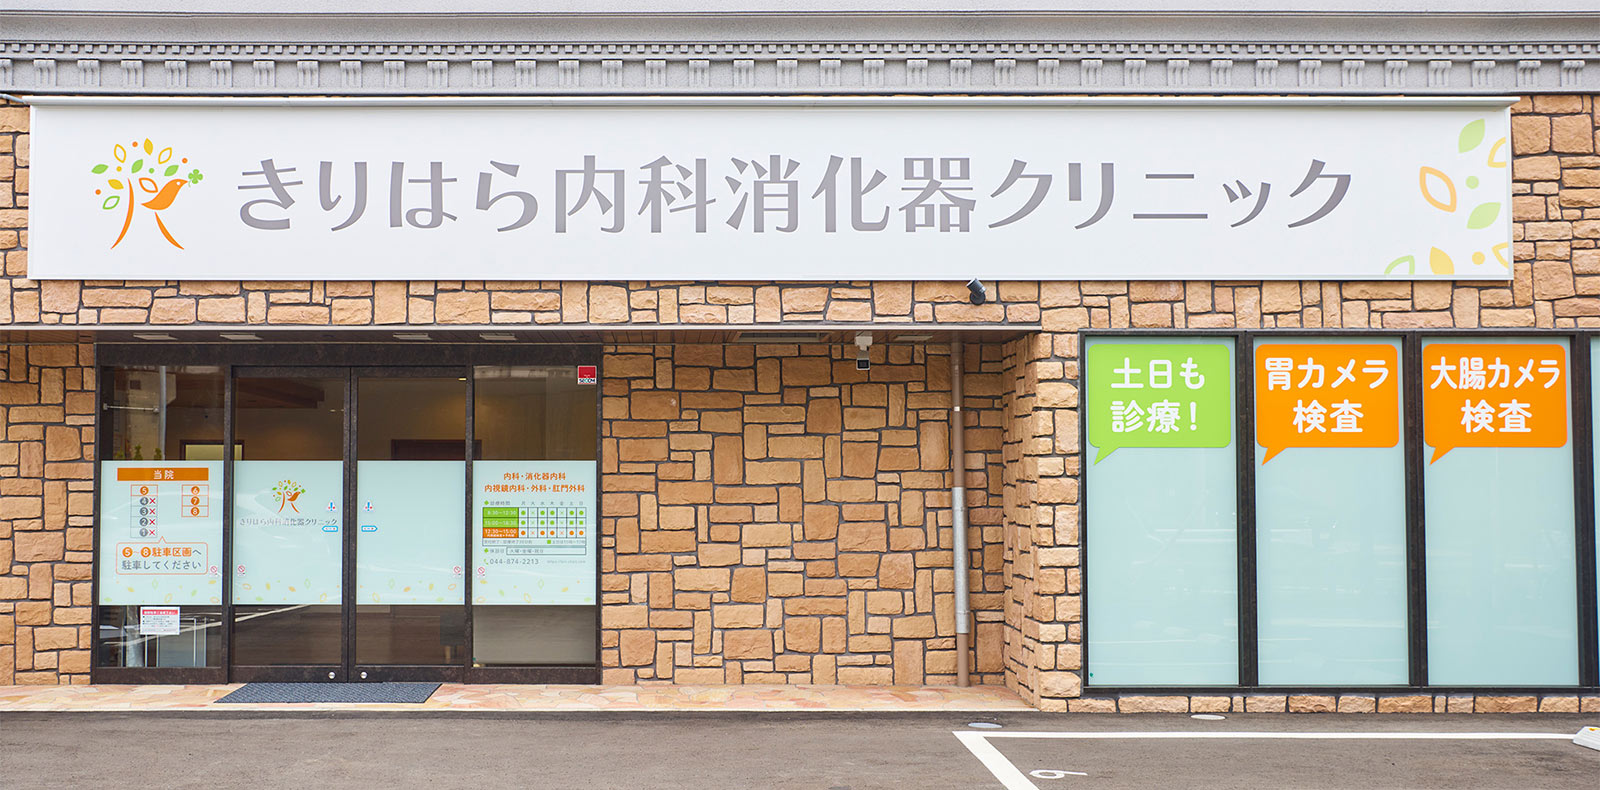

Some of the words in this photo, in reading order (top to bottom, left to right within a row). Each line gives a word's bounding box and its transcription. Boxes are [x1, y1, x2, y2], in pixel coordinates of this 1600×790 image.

[237, 154, 1352, 233] きりはら内科消化器クリニック
[1110, 357, 1205, 390] 土日も
[1265, 357, 1390, 391] 胃カメラ
[1430, 356, 1561, 391] 大腸カメラ
[1110, 399, 1197, 433] 診療！
[1292, 398, 1364, 433] 検査
[1460, 398, 1533, 433] 検査
[153, 470, 174, 480] 当院
[484, 484, 585, 492] 内視鏡内科・外科・肛門外科
[503, 472, 566, 480] 内科・消化器内科
[121, 560, 202, 570] 駐車してください
